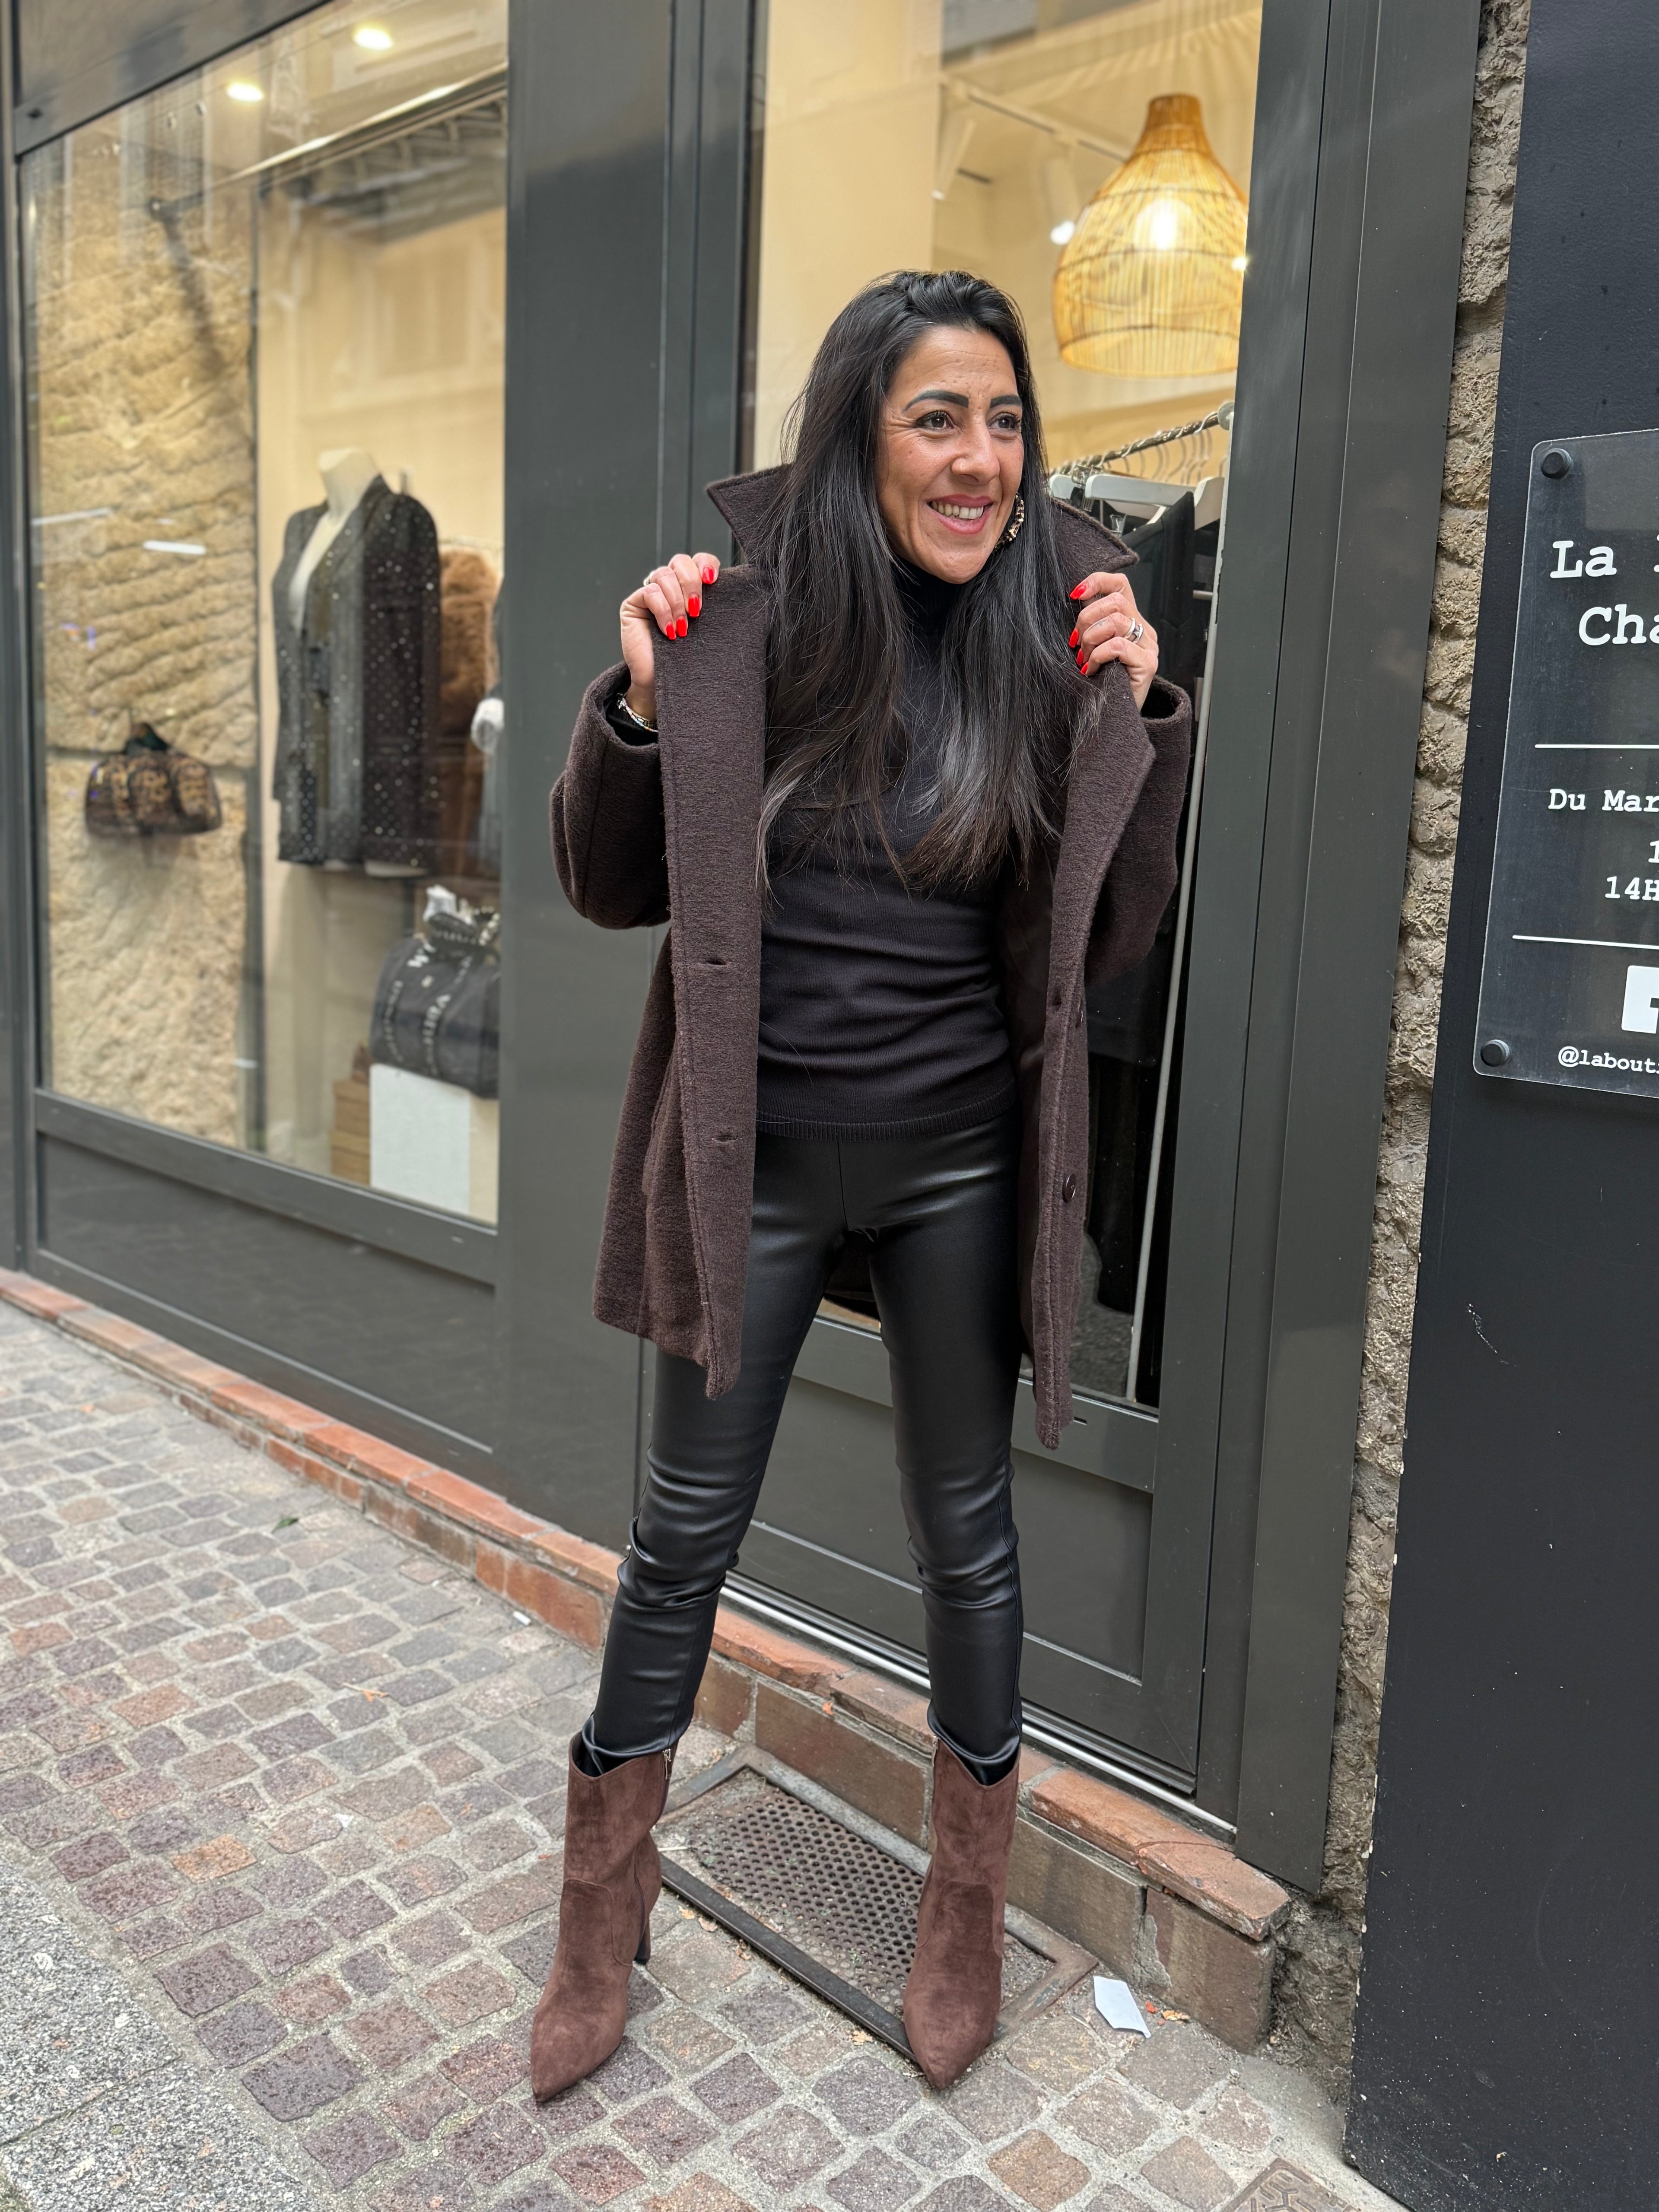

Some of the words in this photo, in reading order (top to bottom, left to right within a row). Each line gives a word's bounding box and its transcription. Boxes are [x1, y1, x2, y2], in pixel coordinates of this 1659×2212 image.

[1550, 540, 1617, 578] La
[1548, 788, 1586, 810] Du
[1602, 789, 1659, 812] Mar
[1605, 876, 1659, 901] 14H
[1558, 1046, 1659, 1074] @labout
